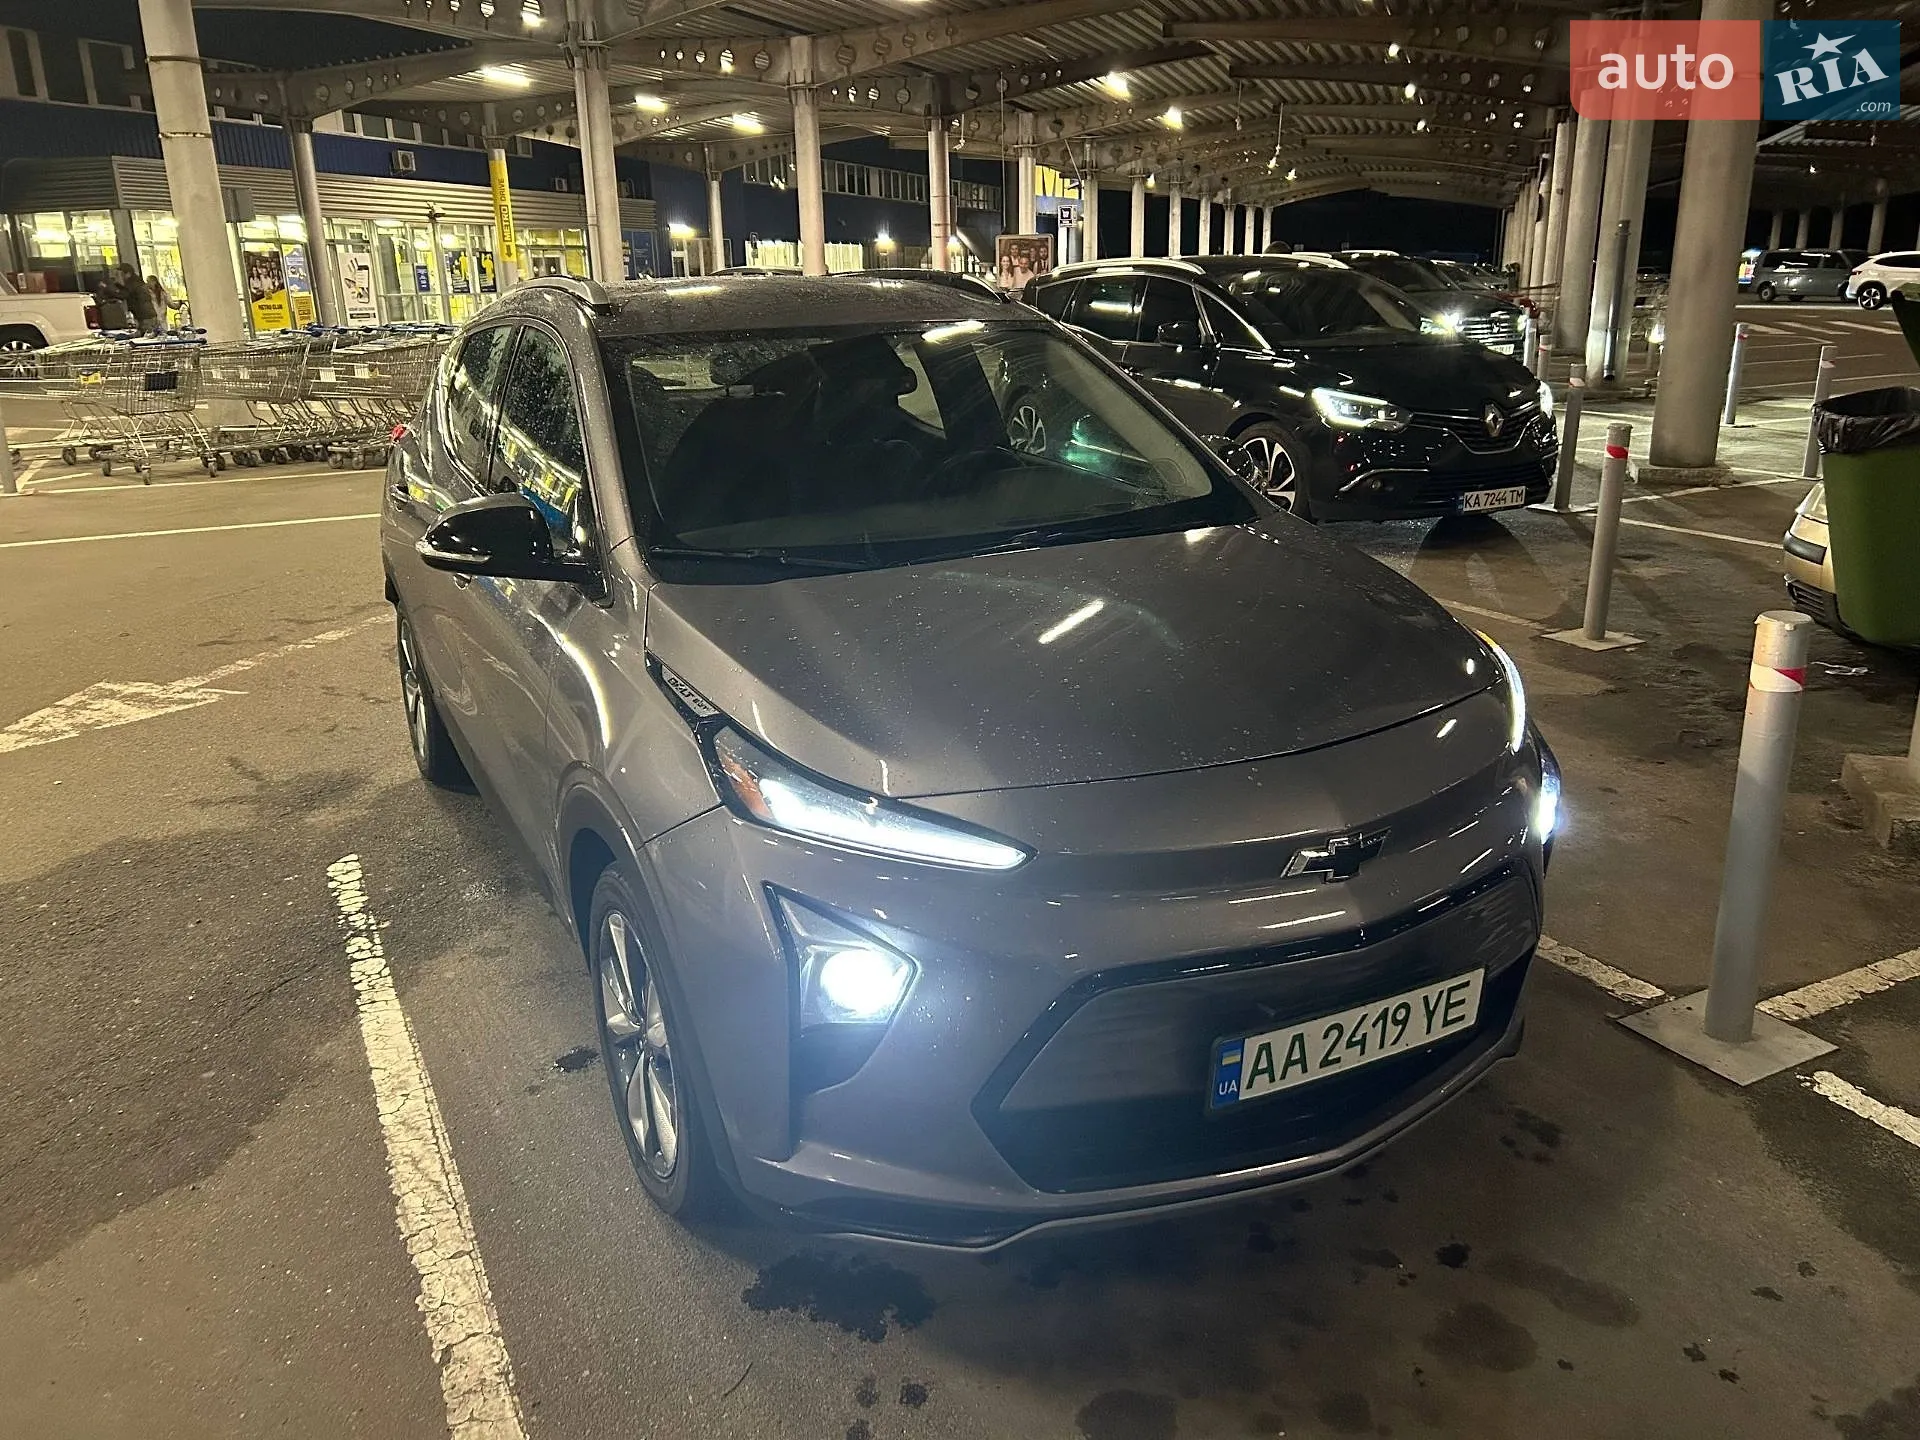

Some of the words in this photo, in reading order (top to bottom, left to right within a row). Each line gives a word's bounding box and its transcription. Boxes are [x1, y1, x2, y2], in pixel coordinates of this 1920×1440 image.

[498, 178, 506, 202] DRIVE
[500, 205, 512, 242] METRO
[1464, 494, 1480, 508] KA
[1483, 491, 1507, 507] 7244
[1510, 489, 1523, 503] TM
[1245, 1032, 1309, 1090] AA
[1319, 1001, 1412, 1070] 2419
[1422, 980, 1471, 1036] YE
[1218, 1080, 1238, 1096] UA
